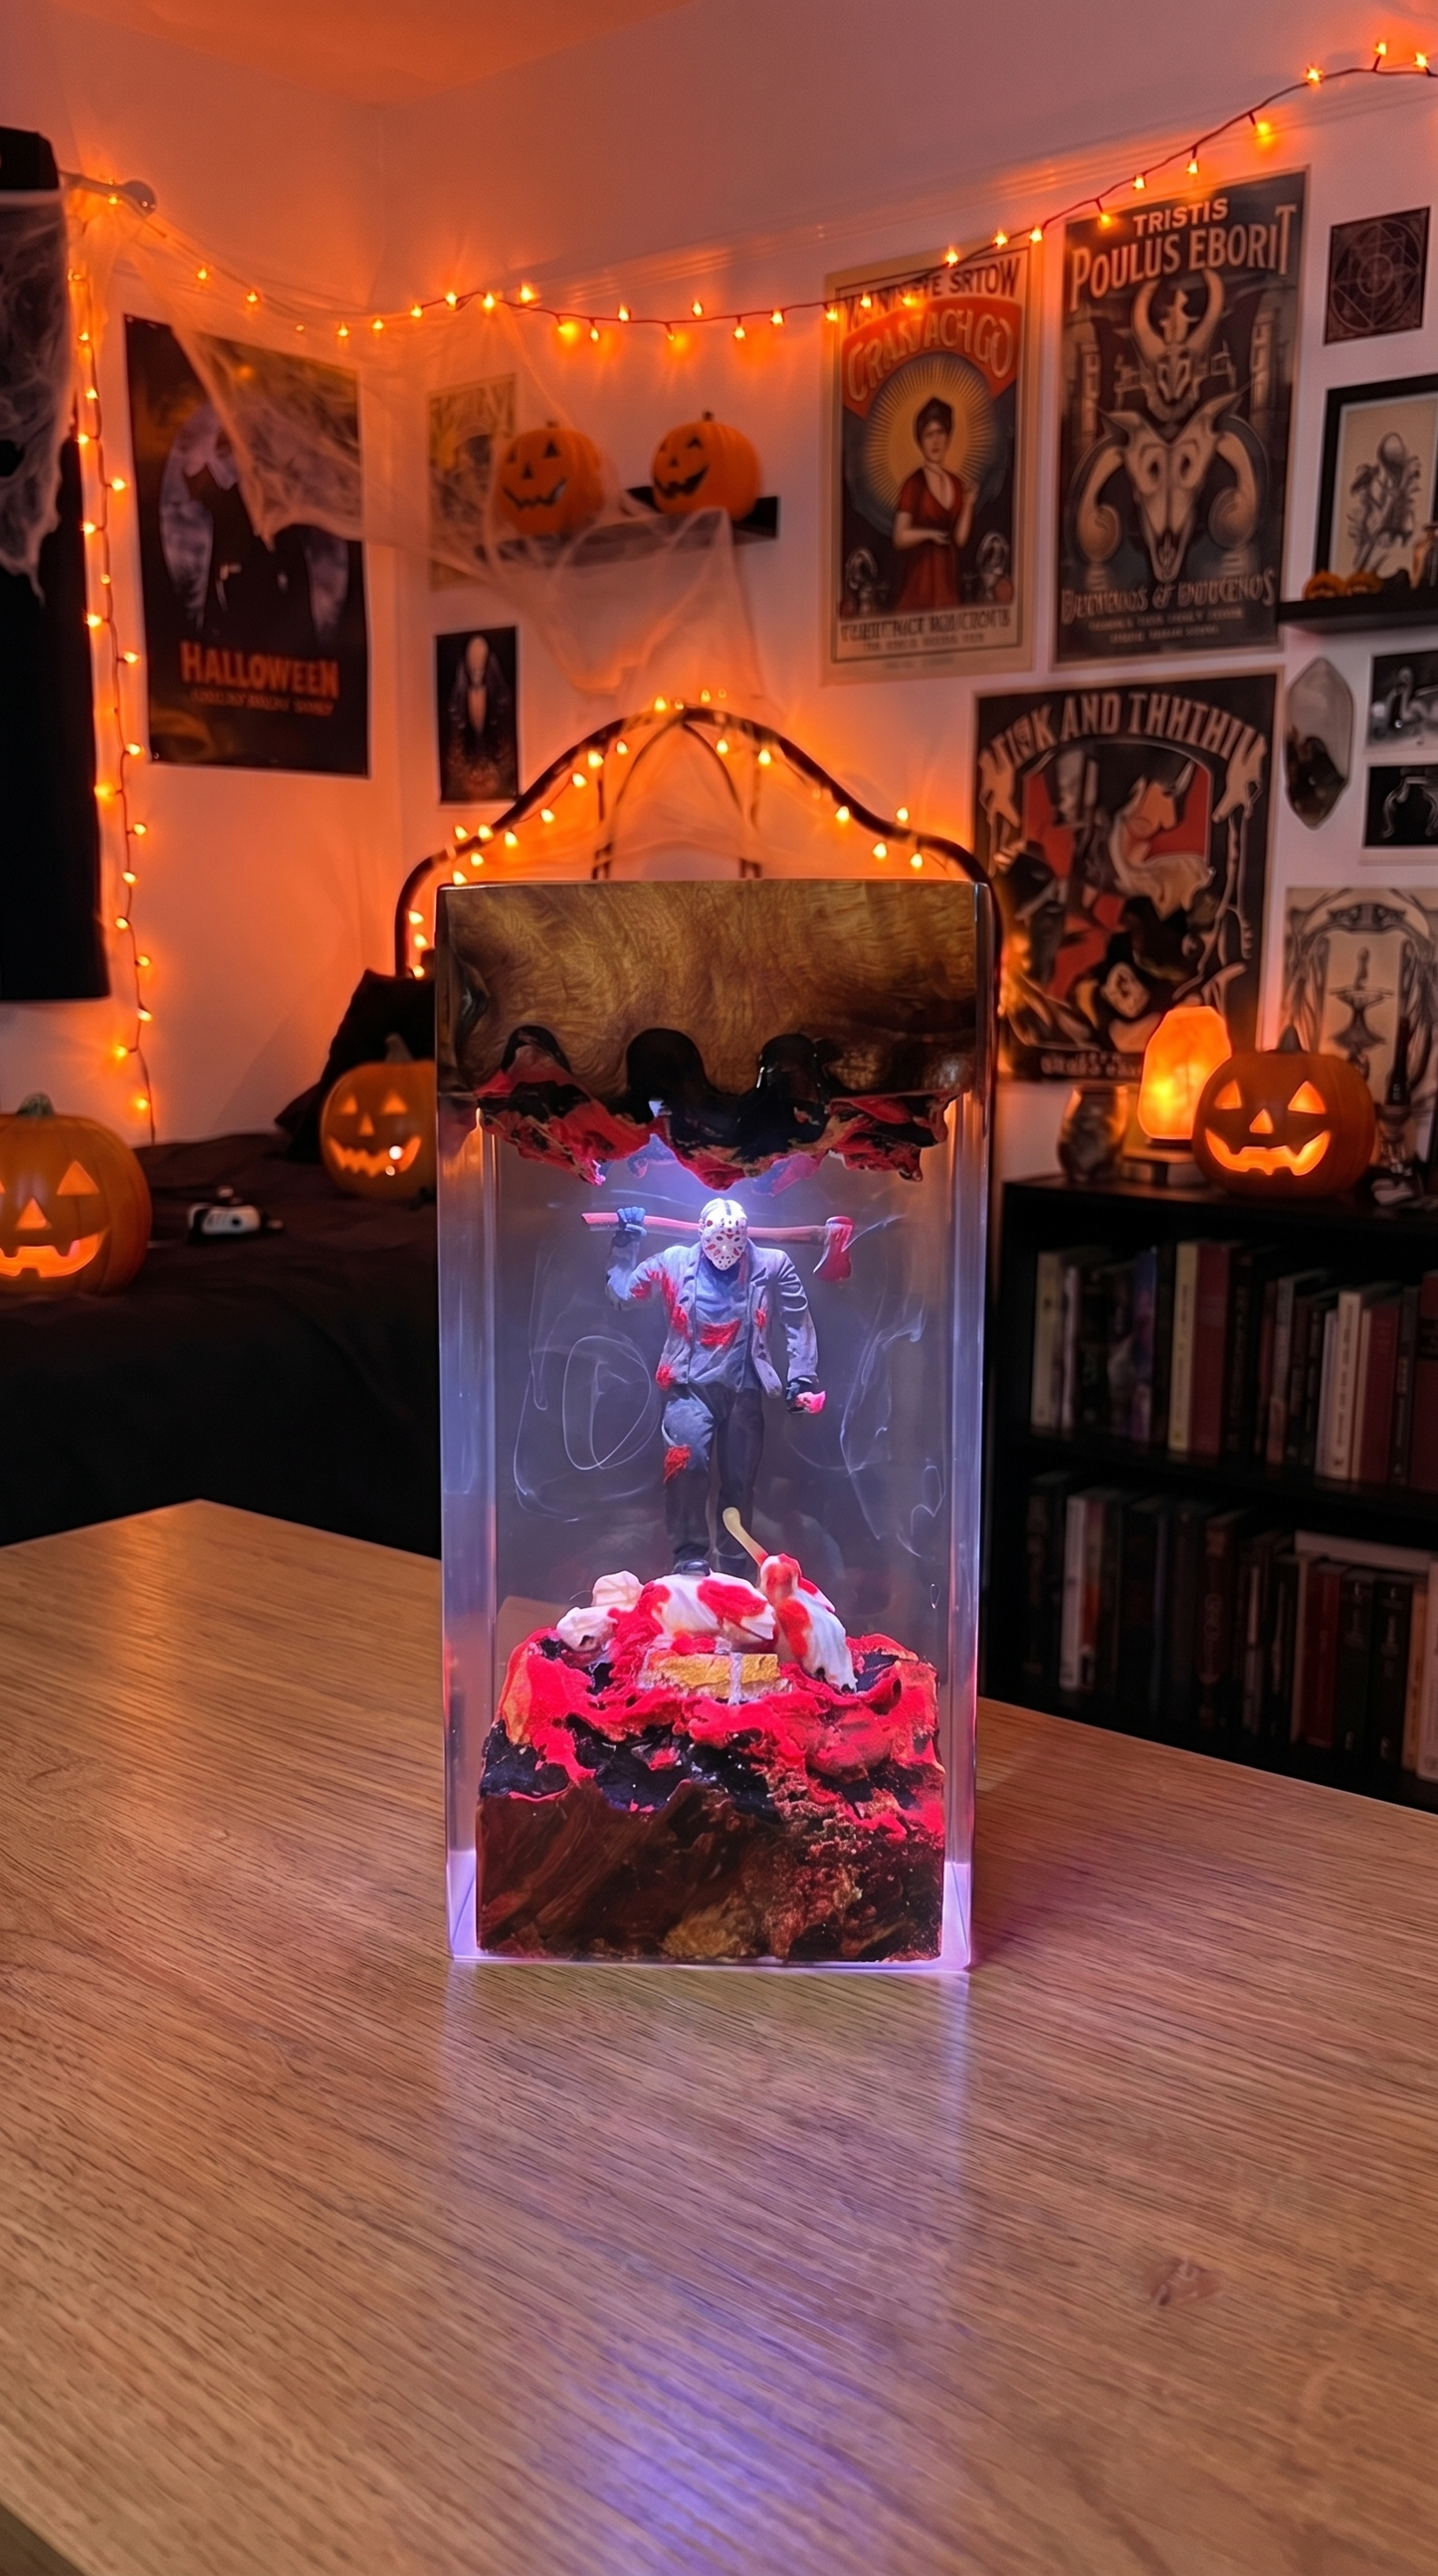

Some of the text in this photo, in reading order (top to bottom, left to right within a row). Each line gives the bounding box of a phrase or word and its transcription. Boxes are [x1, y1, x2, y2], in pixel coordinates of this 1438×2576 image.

[1132, 197, 1230, 238] TRISTIS
[1070, 203, 1298, 313] POULUS EBORIT
[179, 640, 340, 699] HALLOWEEN
[1060, 693, 1122, 742] AND
